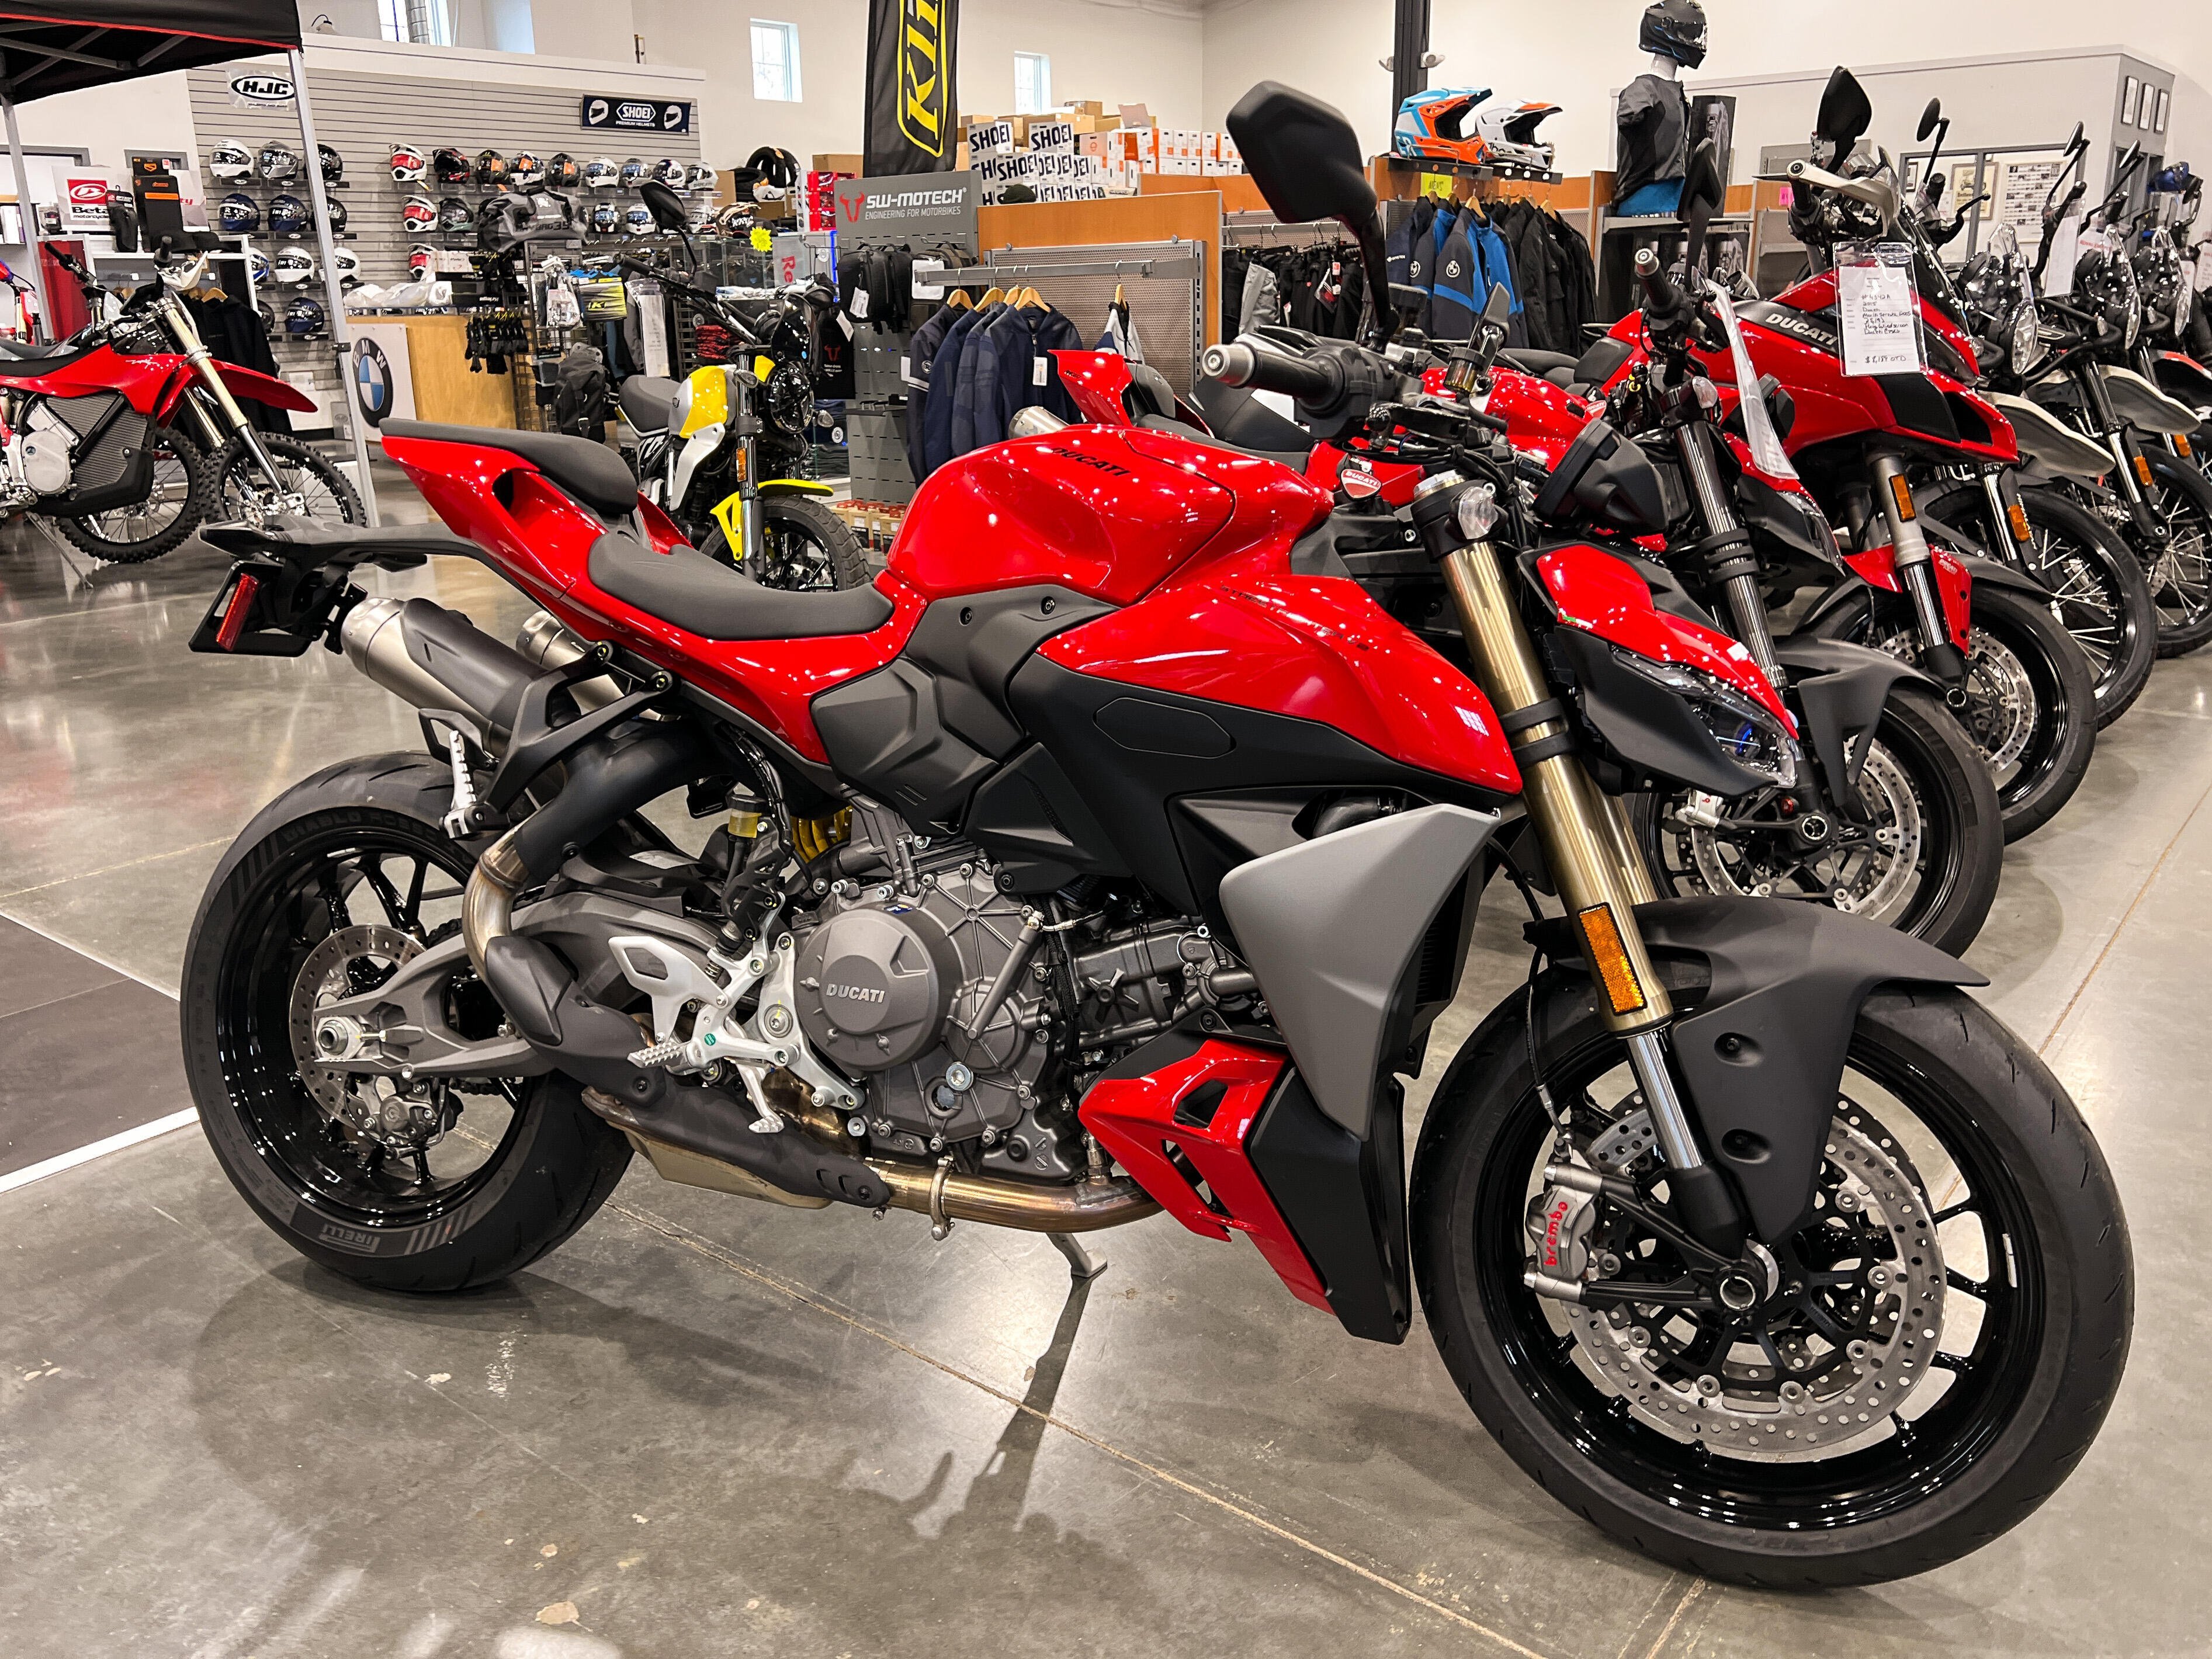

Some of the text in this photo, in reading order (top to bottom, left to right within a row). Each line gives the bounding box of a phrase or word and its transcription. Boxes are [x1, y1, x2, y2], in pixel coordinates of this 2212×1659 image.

[242, 81, 289, 95] HJC
[622, 106, 651, 119] SHOEI
[969, 124, 1010, 152] SHOEI
[1031, 123, 1072, 152] SHOEI
[997, 154, 1037, 182] SHOEI
[865, 206, 961, 220] ENGINEERING FOR MOTORBIKES
[1765, 313, 1839, 346] DUCATI
[353, 339, 387, 369] BMW
[1051, 447, 1131, 476] DUCATI
[1345, 470, 1378, 487] DUCATI
[826, 983, 885, 1003] DUCATI
[318, 1223, 381, 1253] PIRELLI
[1543, 1201, 1568, 1266] brembo
